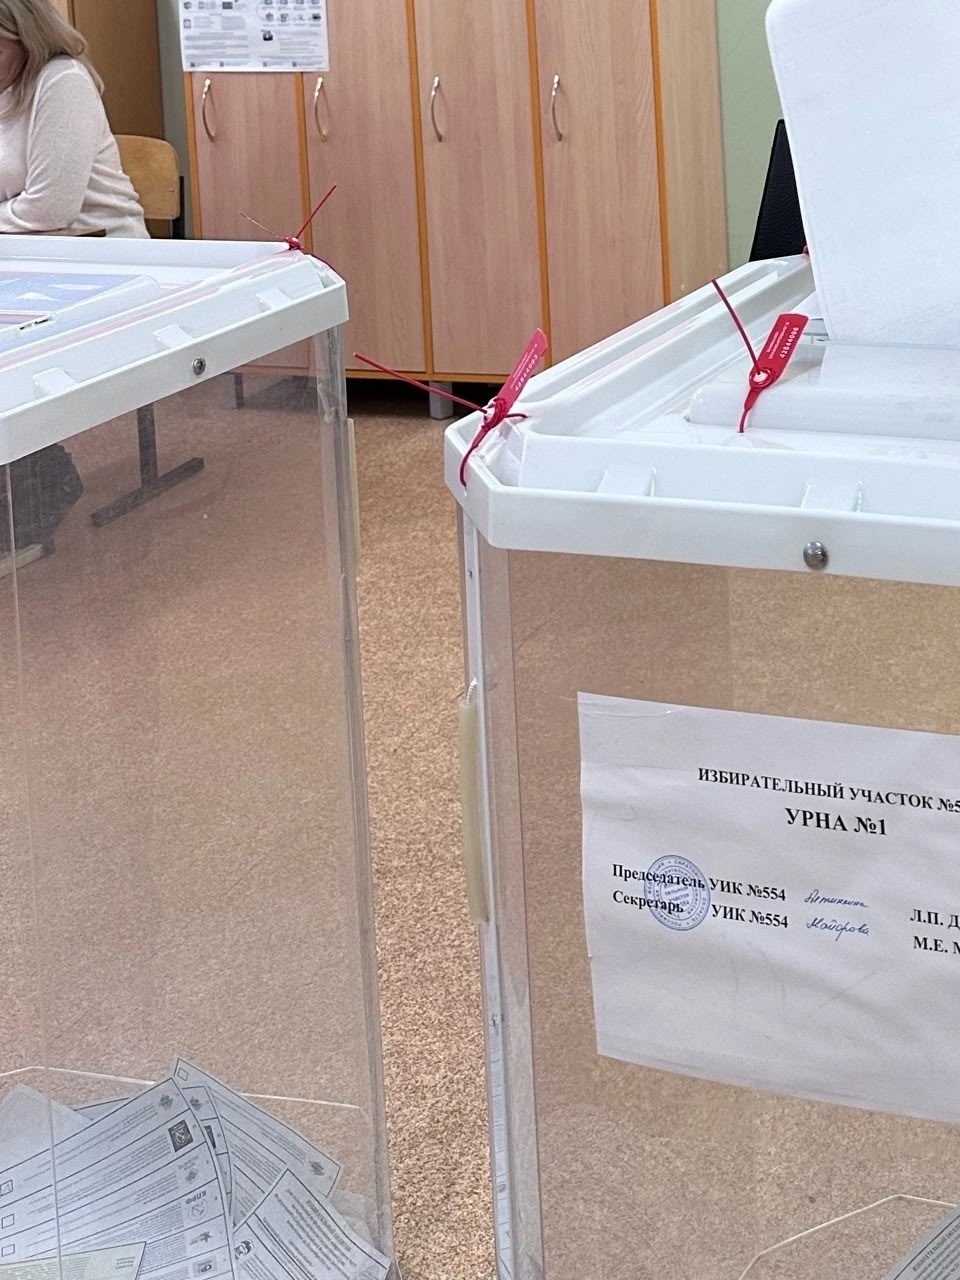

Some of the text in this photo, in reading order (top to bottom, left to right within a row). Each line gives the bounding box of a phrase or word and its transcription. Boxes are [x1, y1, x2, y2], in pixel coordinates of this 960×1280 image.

[698, 767, 844, 800] ИЗБИРАТЕЛЬНЫЙ
[849, 787, 933, 809] УЧАСТОК
[785, 807, 887, 835] УРНА №1
[613, 864, 787, 902] Председатель УИК №554
[613, 890, 684, 915] Секретарь
[712, 904, 745, 922] УИК
[750, 910, 789, 929] №554
[910, 908, 943, 927] Л.П.
[913, 935, 947, 953] М.Е.
[185, 1189, 207, 1205] КПРФ
